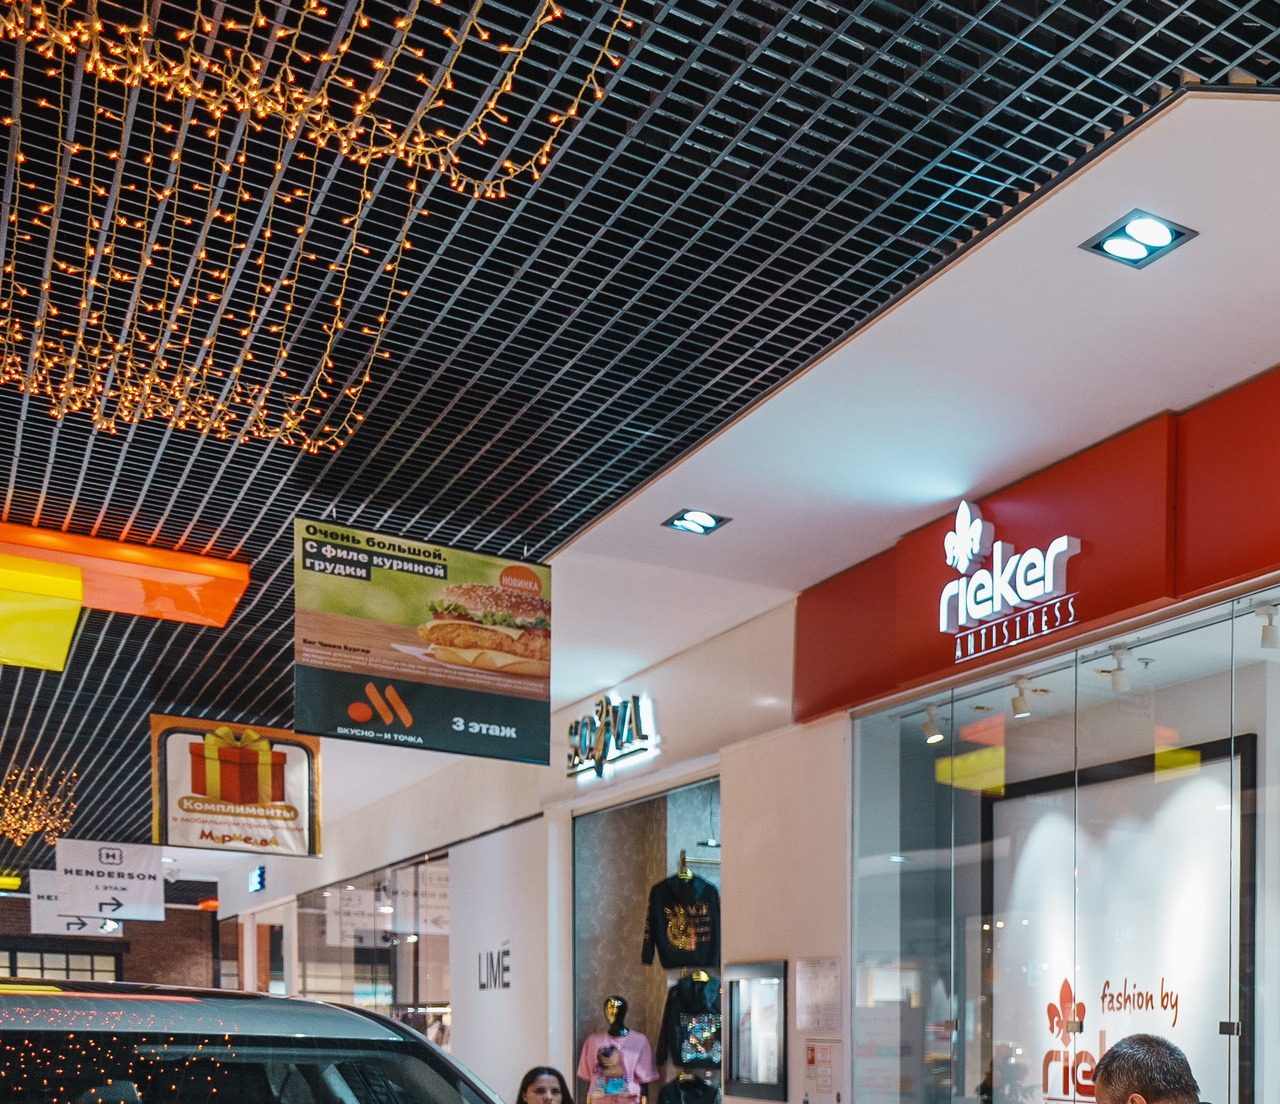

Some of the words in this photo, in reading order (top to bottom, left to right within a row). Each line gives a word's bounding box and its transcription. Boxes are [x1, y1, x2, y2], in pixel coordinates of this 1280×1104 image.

[305, 524, 361, 545] Очень
[365, 536, 448, 562] большой.
[304, 540, 319, 553] С
[321, 543, 369, 563] филе
[372, 555, 445, 578] куриной
[305, 557, 368, 578] грудки
[502, 575, 540, 591] НОВИНКА
[939, 534, 1072, 633] rieker
[955, 597, 1075, 660] ANTISTRESS
[336, 726, 376, 738] ВКУСНО
[393, 733, 424, 744] ТОЧКА
[451, 715, 465, 731] 3
[468, 721, 518, 738] этаж
[182, 798, 296, 819] Комплименты
[63, 868, 158, 881] HENDERSON
[1100, 978, 1155, 1015] fashion
[1160, 977, 1179, 1028] by
